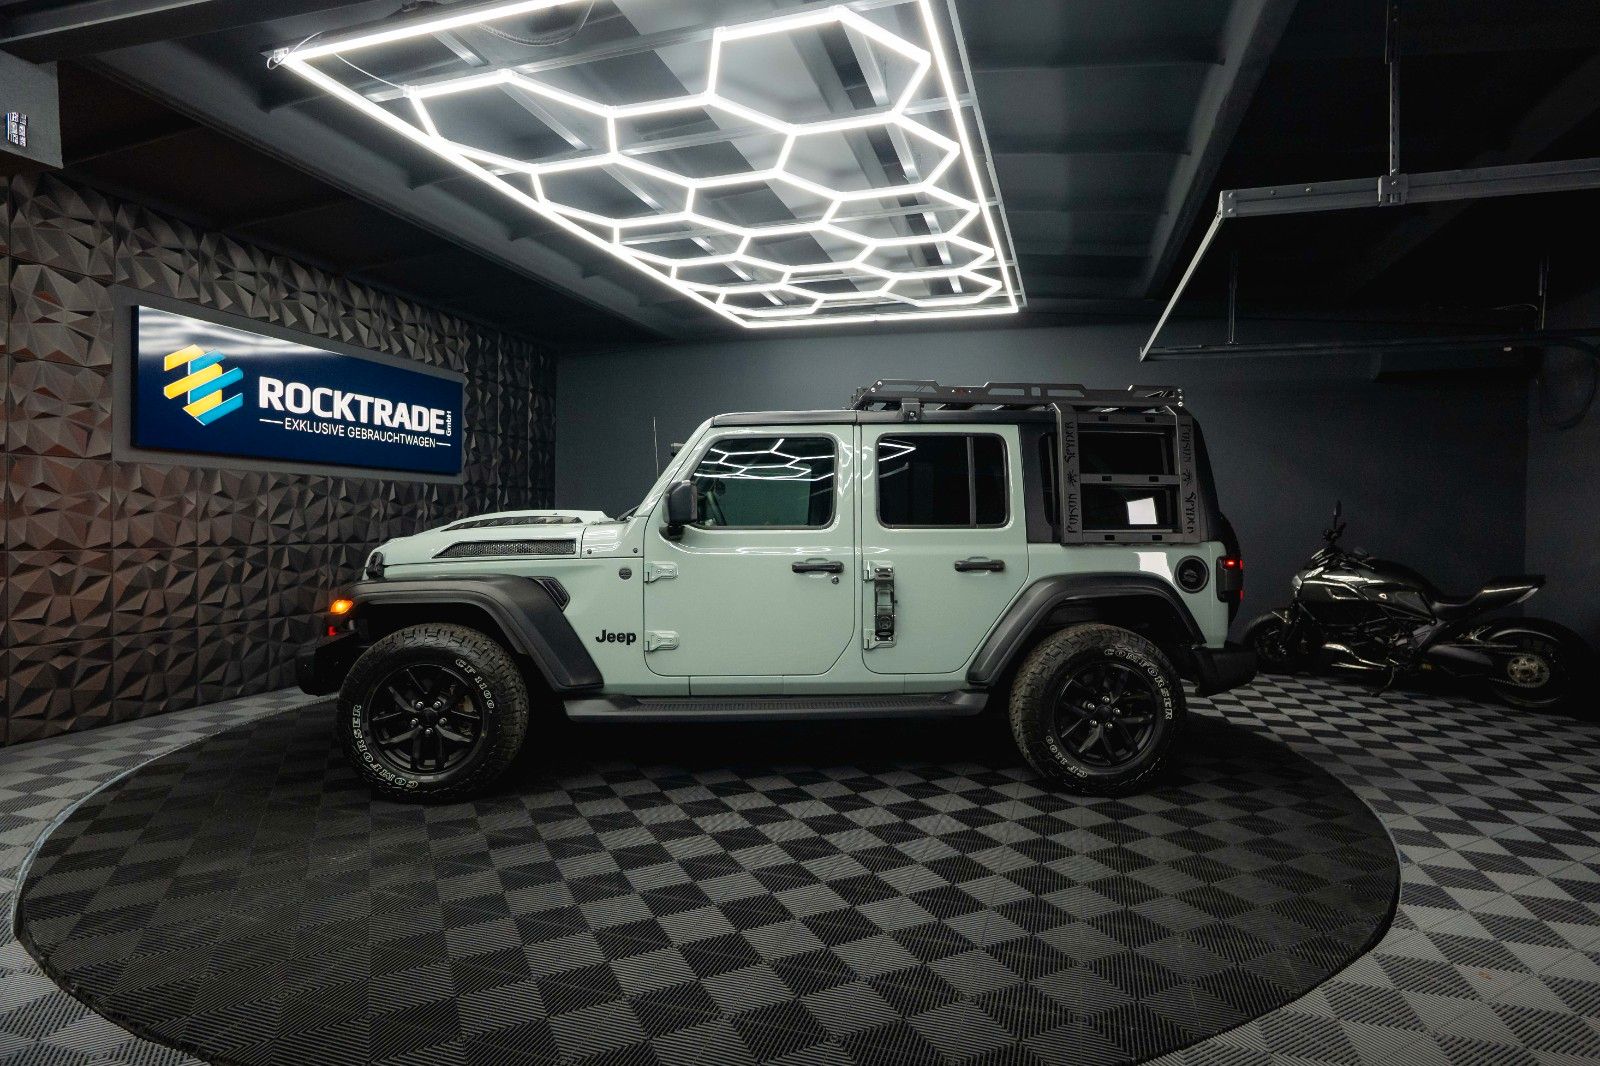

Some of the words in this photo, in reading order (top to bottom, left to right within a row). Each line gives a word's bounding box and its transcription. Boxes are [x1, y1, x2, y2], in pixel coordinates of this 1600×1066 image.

[259, 376, 445, 435] ROCKTRADE
[284, 417, 345, 437] EXKLUSIVE
[347, 426, 436, 448] GEBRAUCHTWAGEN
[595, 629, 637, 645] Jeep
[352, 704, 419, 789] COMFORSER
